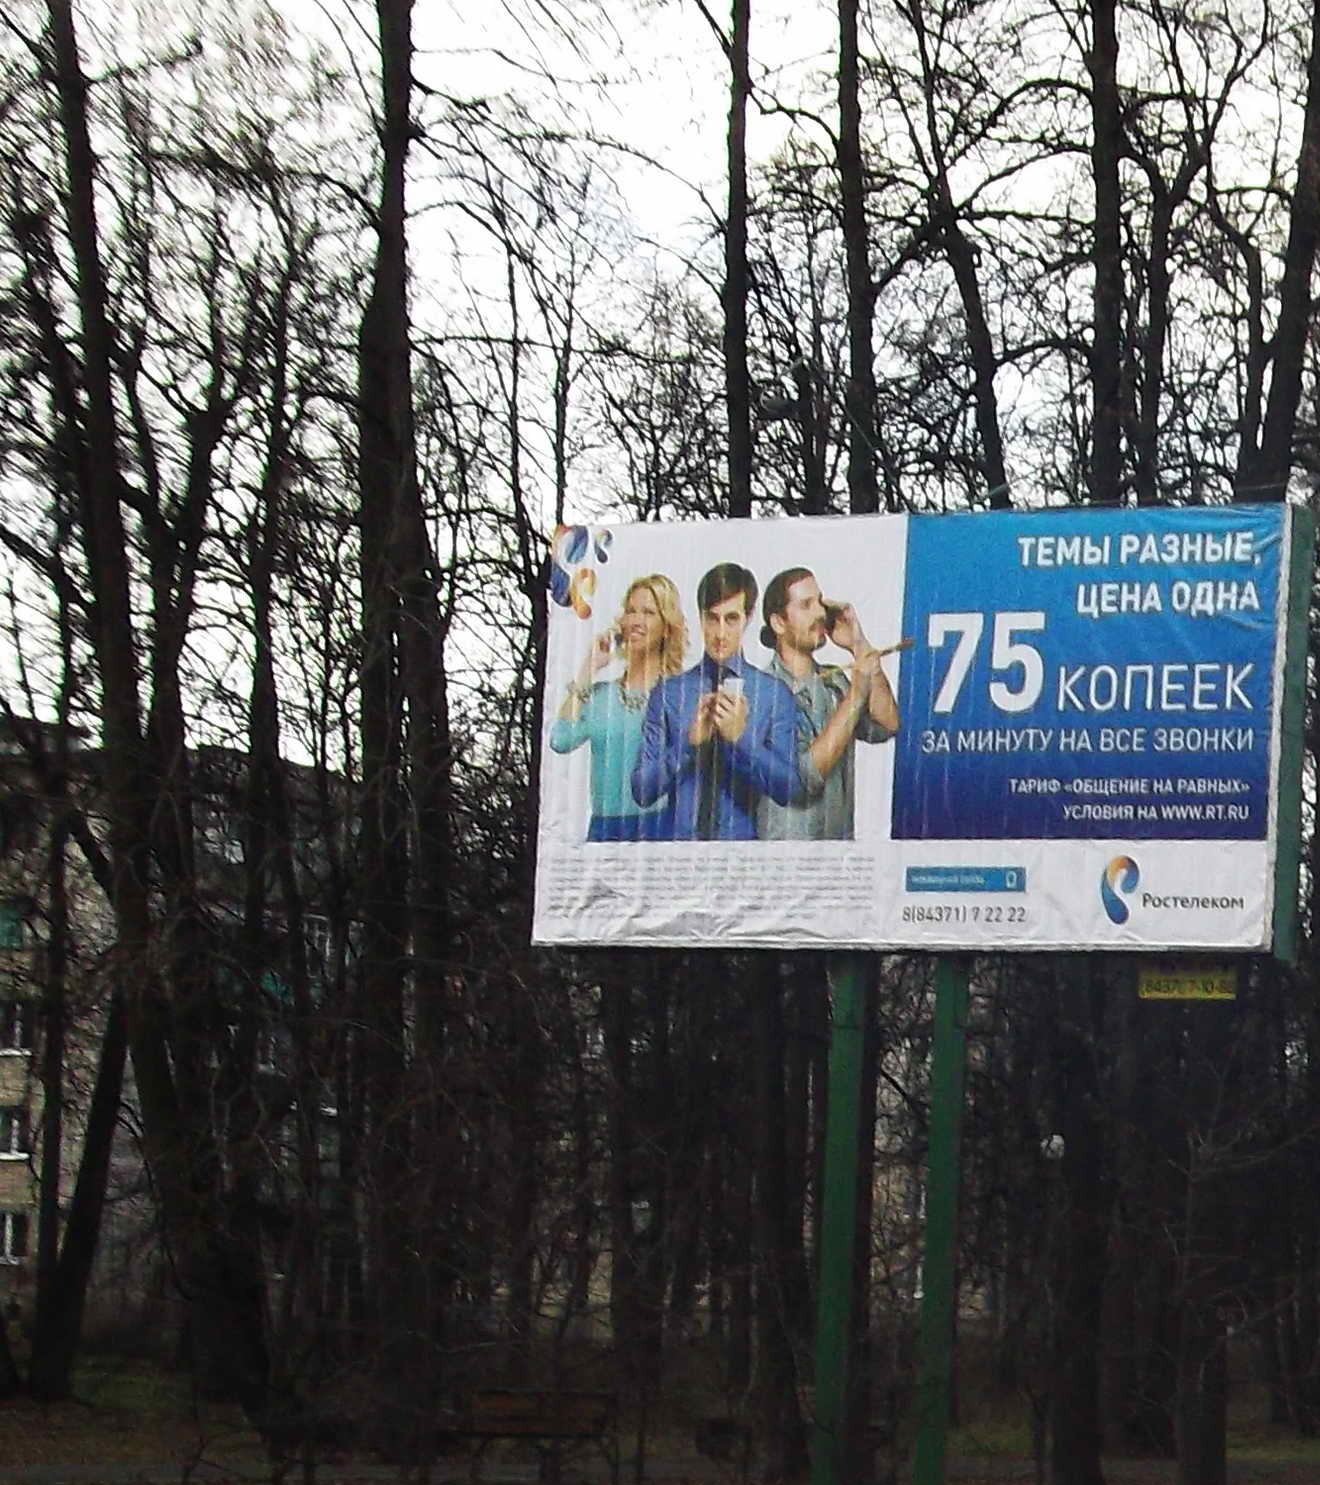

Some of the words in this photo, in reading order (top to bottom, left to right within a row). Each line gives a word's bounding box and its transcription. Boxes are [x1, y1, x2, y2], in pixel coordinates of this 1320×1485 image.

[1018, 535, 1109, 567] ТЕМЫ
[1119, 531, 1262, 567] РАЗНЫЕ,
[1077, 582, 1162, 618] ЦЕНА
[1172, 581, 1260, 617] ОДНА
[927, 611, 1045, 714] 75
[1057, 662, 1255, 712] КОПЕЕК
[922, 729, 950, 753] ЗА
[958, 728, 1053, 752] МИНУТУ
[1059, 728, 1093, 752] НА
[1100, 728, 1147, 752] ВСЕ
[1153, 727, 1254, 752] ЗВОНКИ
[1010, 778, 1061, 795] ТАРИФ
[1153, 778, 1174, 794] НА
[1177, 778, 1251, 794] РАВНЫХ»
[1063, 804, 1134, 820] УСЛОВИЯ
[1138, 804, 1158, 820] НА
[1161, 804, 1249, 820] WWW.RT.RU
[1141, 893, 1244, 910] Ростелеком
[985, 906, 1002, 923] 22
[1008, 906, 1026, 923] 22
